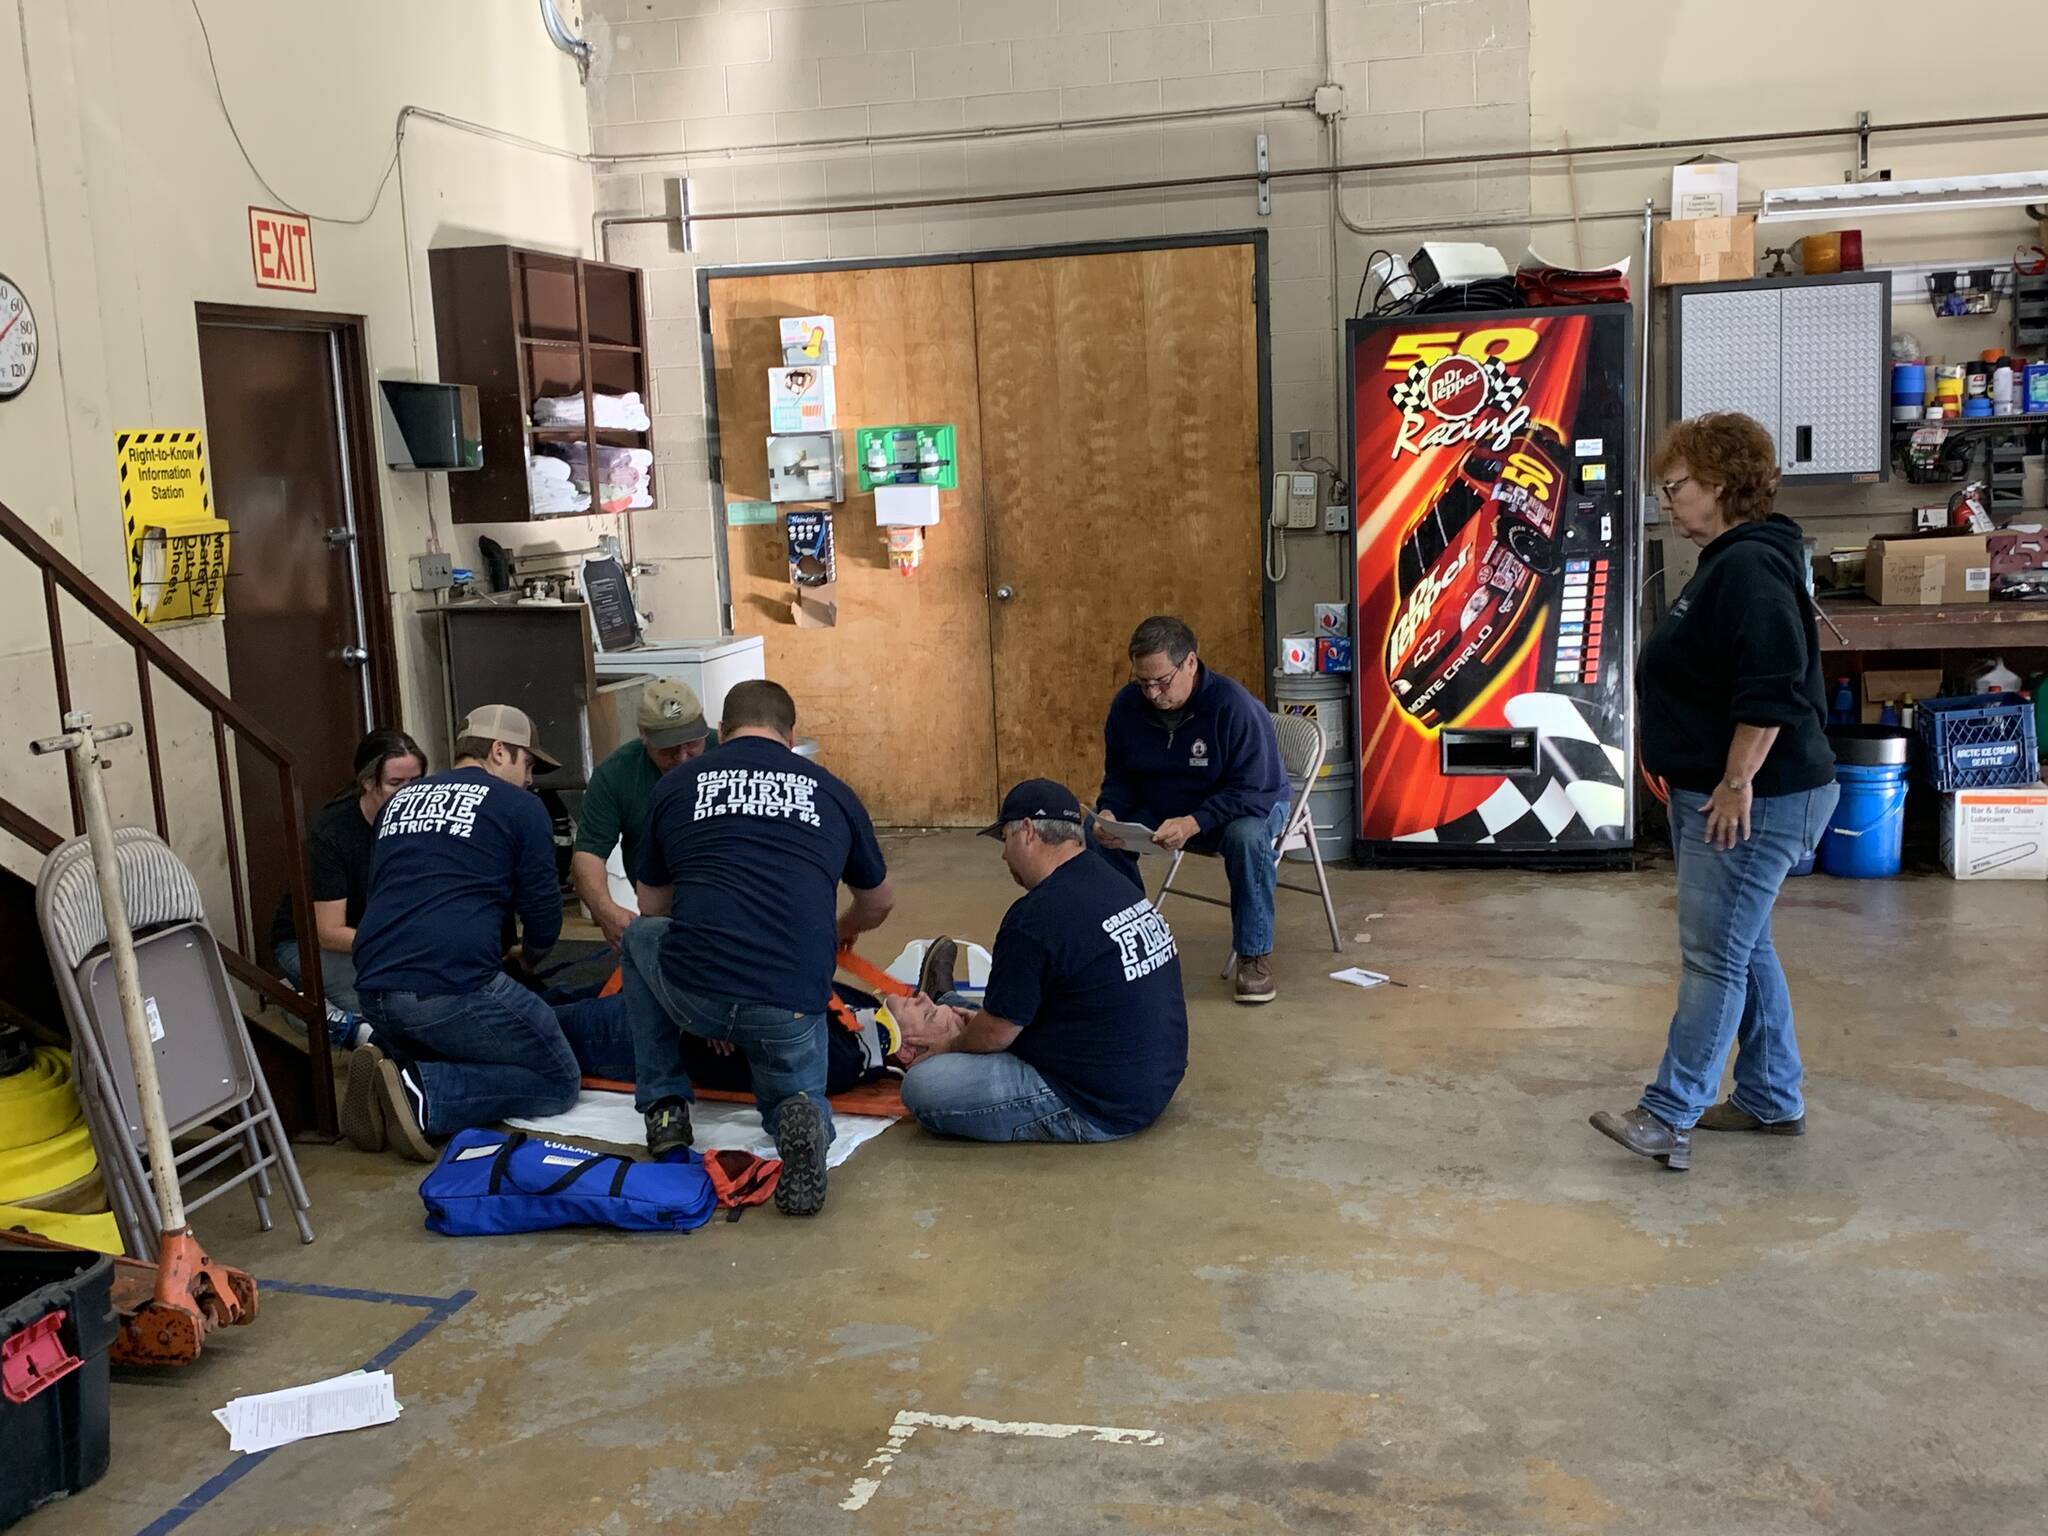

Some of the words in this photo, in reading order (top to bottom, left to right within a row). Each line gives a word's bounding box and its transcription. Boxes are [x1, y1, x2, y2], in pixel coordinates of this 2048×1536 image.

[257, 219, 306, 283] EXIT
[0, 286, 8, 300] 0
[11, 298, 23, 313] 60
[20, 321, 33, 335] 80
[21, 342, 35, 356] 100
[1383, 327, 1540, 370] 50
[11, 363, 26, 377] 120
[1444, 368, 1463, 386] Dr
[1431, 370, 1480, 403] Pepper
[1391, 405, 1530, 459] Racing
[128, 448, 196, 465] Right-to-Know
[138, 467, 192, 481] Information
[1501, 452, 1554, 501] 50
[151, 485, 185, 501] Station
[183, 536, 197, 582] Data
[191, 534, 211, 598] Safety
[202, 532, 224, 608] Material
[163, 537, 185, 606] Sheets
[1409, 564, 1440, 608] Dr
[1390, 541, 1474, 678] Pepper
[1408, 678, 1446, 713] MONTE
[1443, 624, 1493, 681] CARLO
[1956, 748, 1980, 758] ARCTIC
[1981, 747, 1992, 757] ICE
[1992, 745, 2017, 755] CREAM
[1971, 756, 2003, 767] SEATTLE
[433, 783, 490, 796] HARBOR
[697, 769, 748, 783] GRAYS
[753, 770, 818, 788] HARBOR
[695, 778, 815, 813] FIRE
[382, 790, 485, 826] FIRE
[693, 803, 794, 821] DISTRICT
[799, 811, 821, 827] #2
[379, 819, 447, 839] DISTRICT
[448, 823, 473, 838] #2
[1970, 816, 2005, 824] Lubricant
